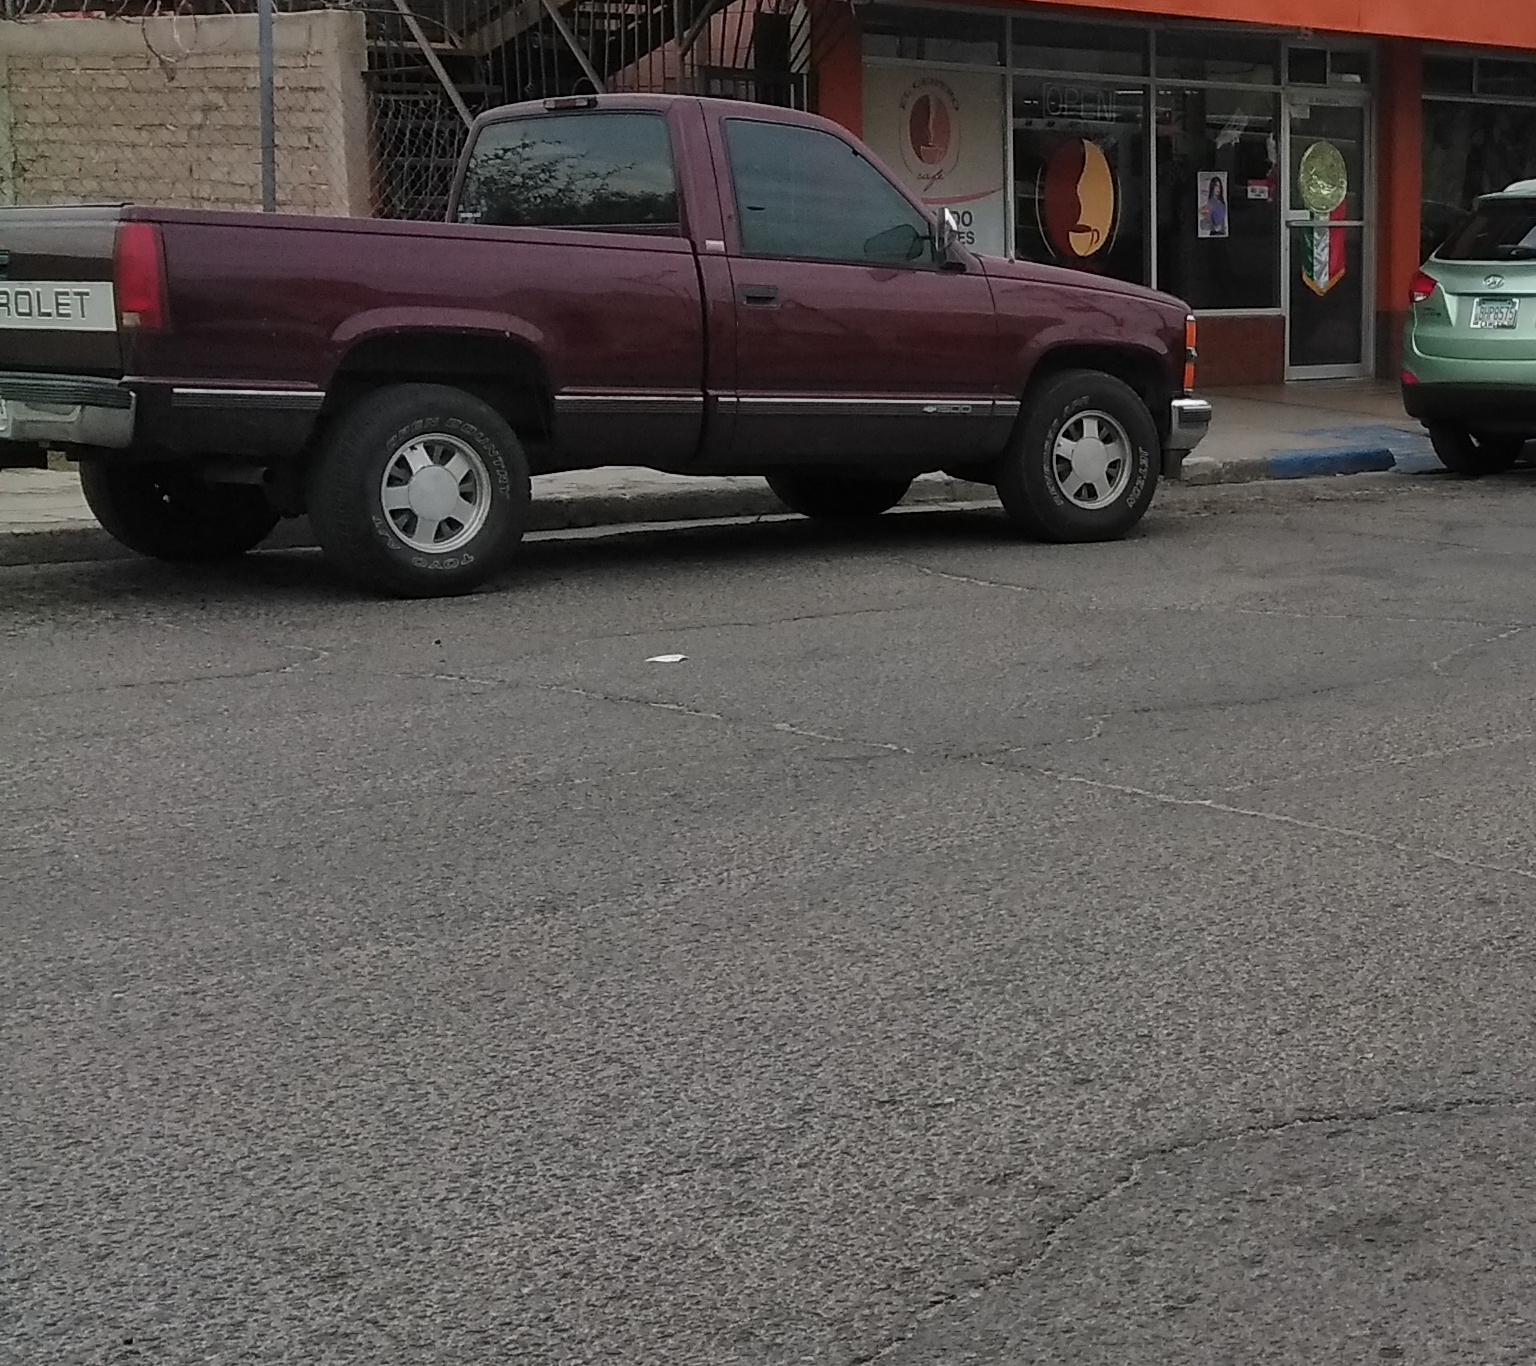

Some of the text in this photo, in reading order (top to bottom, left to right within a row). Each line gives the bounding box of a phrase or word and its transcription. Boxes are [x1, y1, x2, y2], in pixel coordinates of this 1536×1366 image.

[1047, 86, 1113, 121] OPEN
[446, 417, 510, 500] COUNTRY
[411, 553, 475, 570] TOYO
